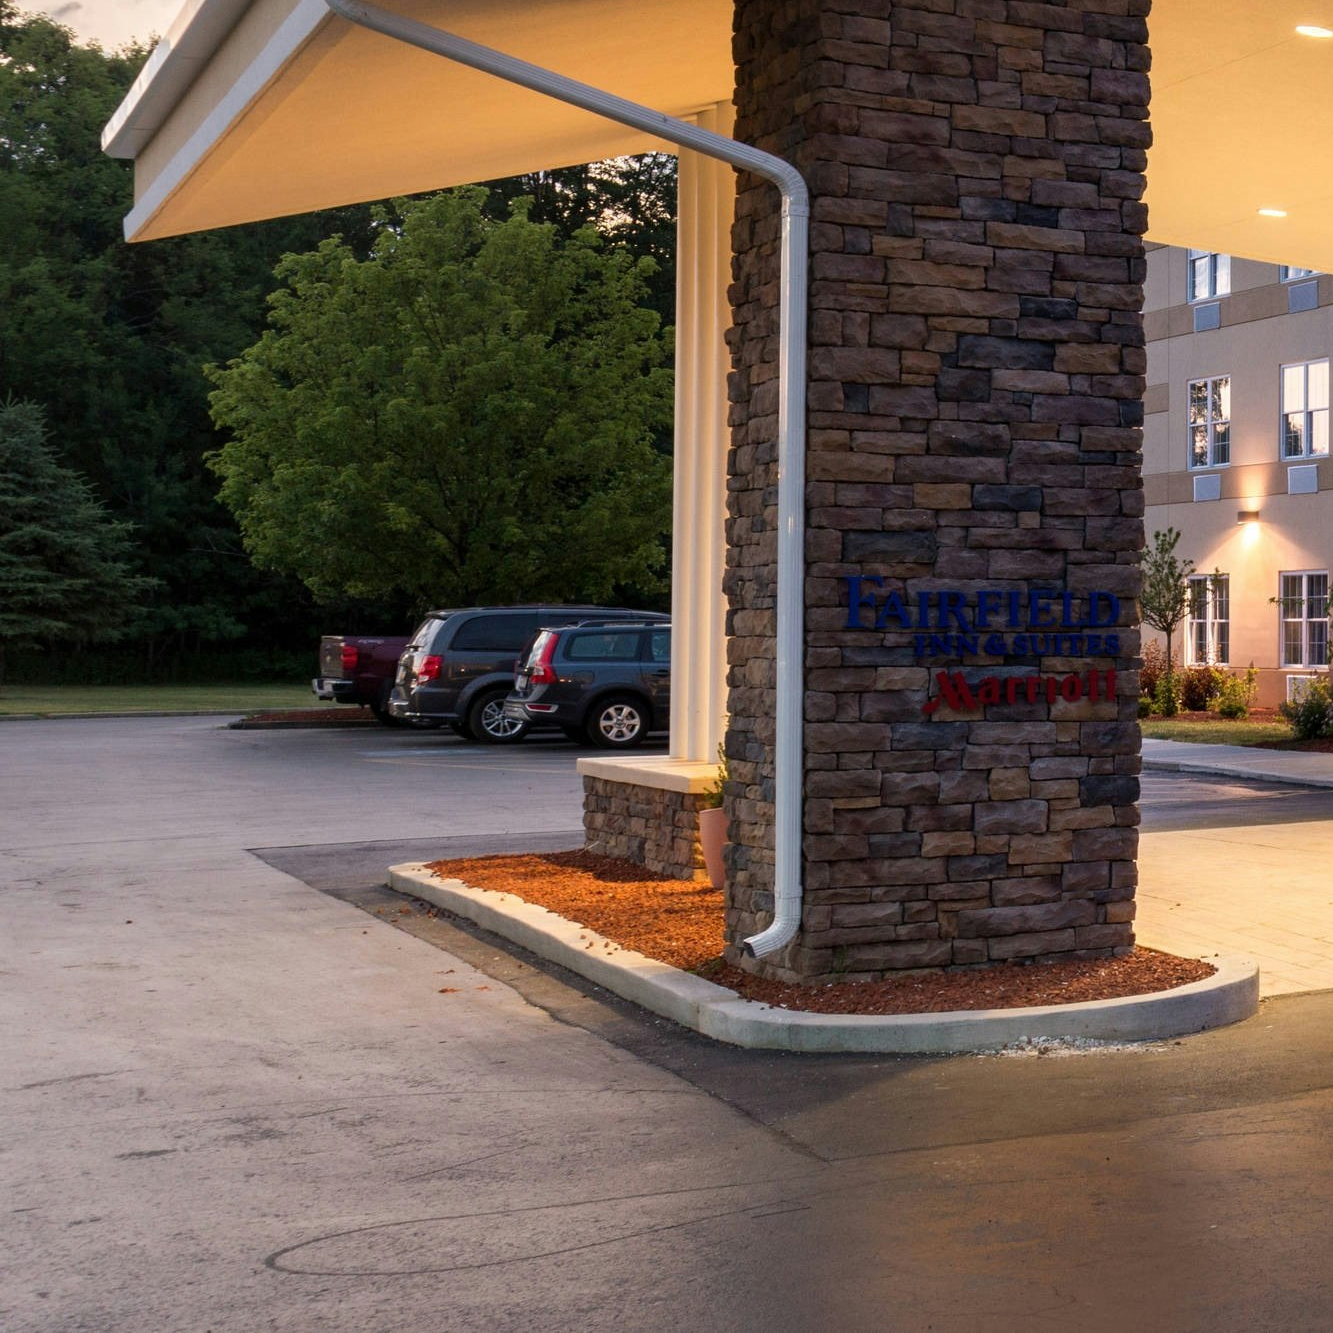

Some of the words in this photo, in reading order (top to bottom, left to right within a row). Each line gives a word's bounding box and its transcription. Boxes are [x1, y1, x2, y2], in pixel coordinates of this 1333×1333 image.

[843, 574, 1121, 634] FAIRFIELD
[912, 633, 979, 658] INN
[983, 633, 1009, 657] &
[1011, 633, 1121, 657] SUITES
[921, 668, 1118, 715] Marriott
